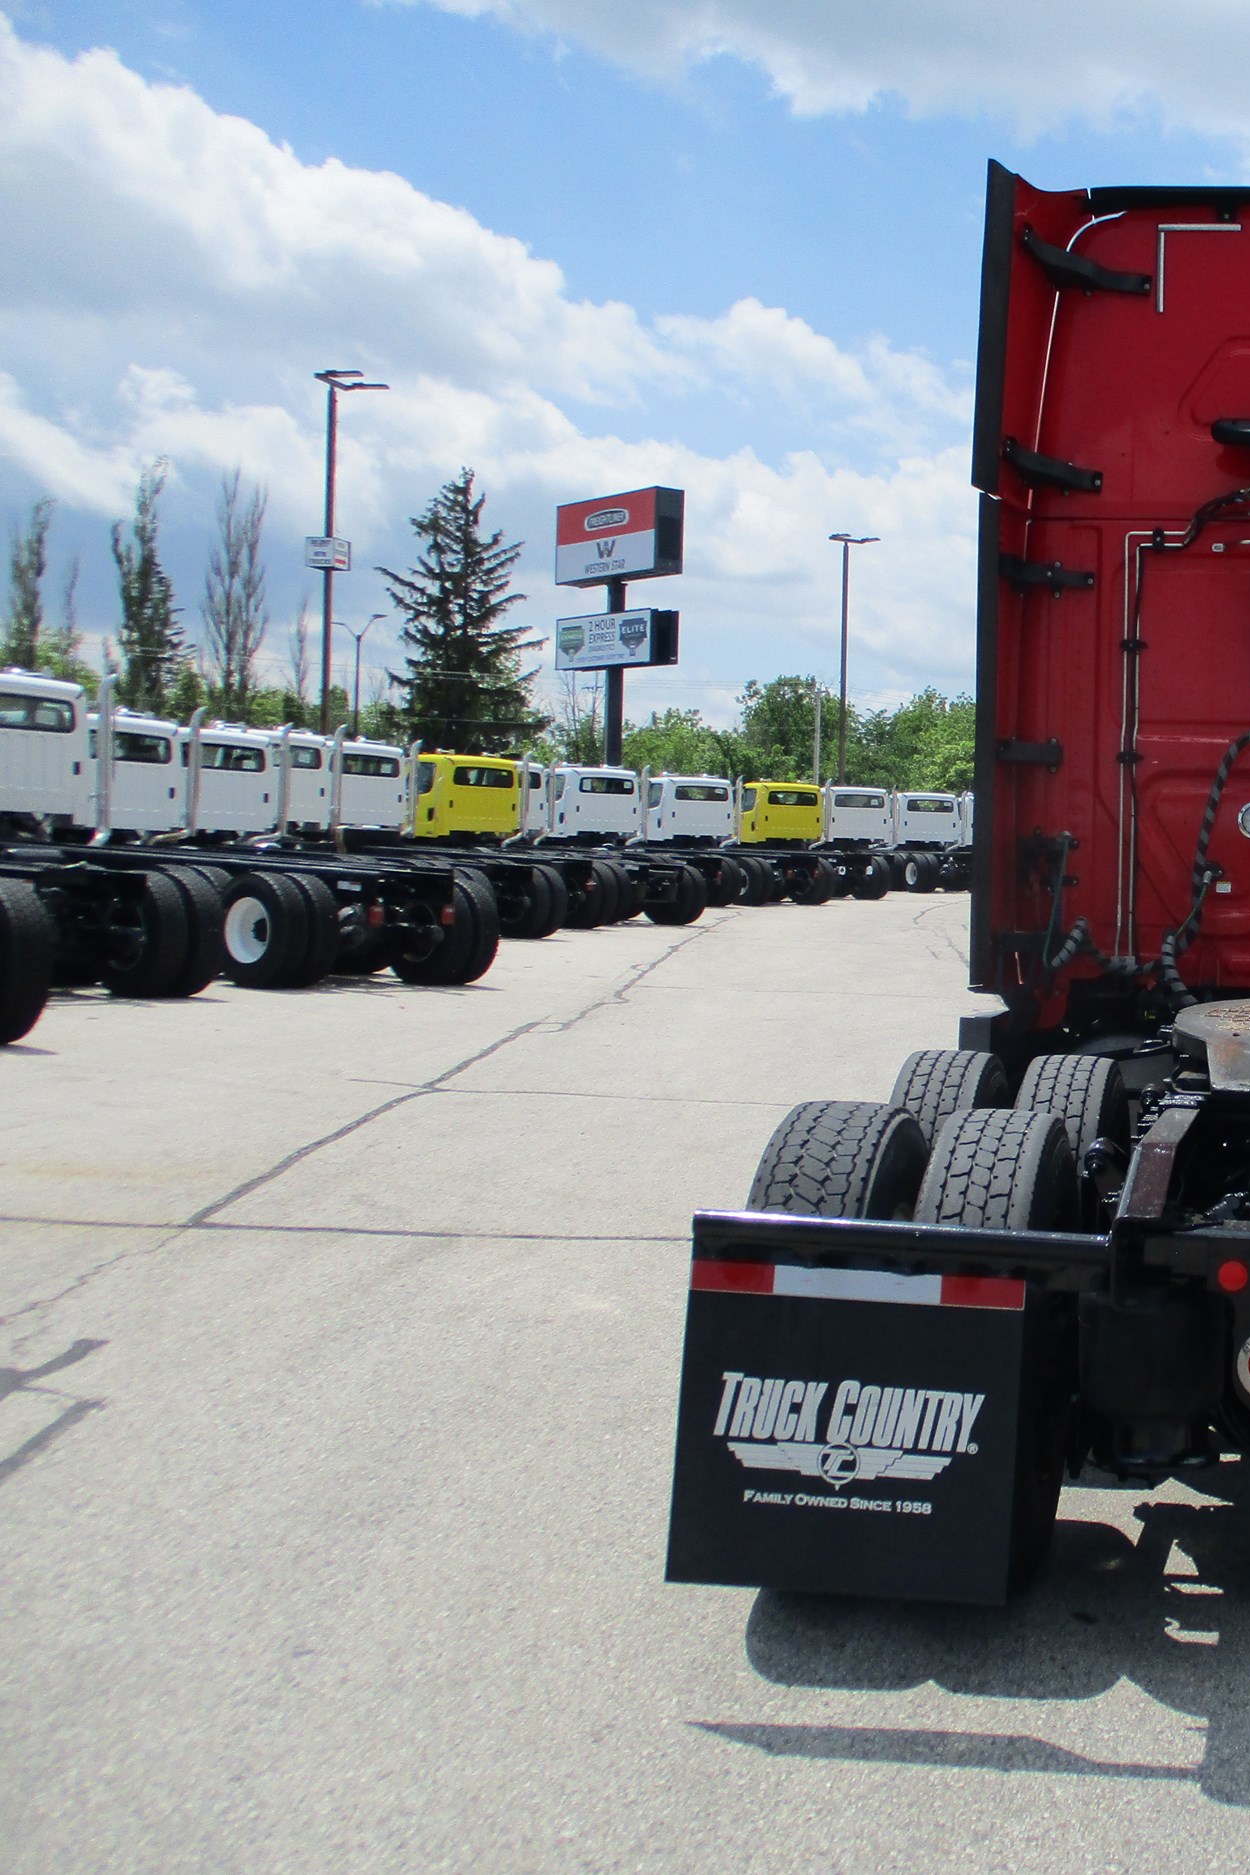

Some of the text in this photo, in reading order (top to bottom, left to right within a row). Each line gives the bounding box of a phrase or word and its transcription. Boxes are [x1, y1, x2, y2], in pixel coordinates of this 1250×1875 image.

[585, 559, 626, 574] WESTERN STAR
[588, 617, 616, 632] 2 HOUR
[621, 624, 645, 634] ELITE
[588, 631, 616, 644] EXPRESS
[713, 1371, 986, 1453] TRUCK COUNTRY
[743, 1489, 932, 1515] FAMILY OWNED SINCE 1958
